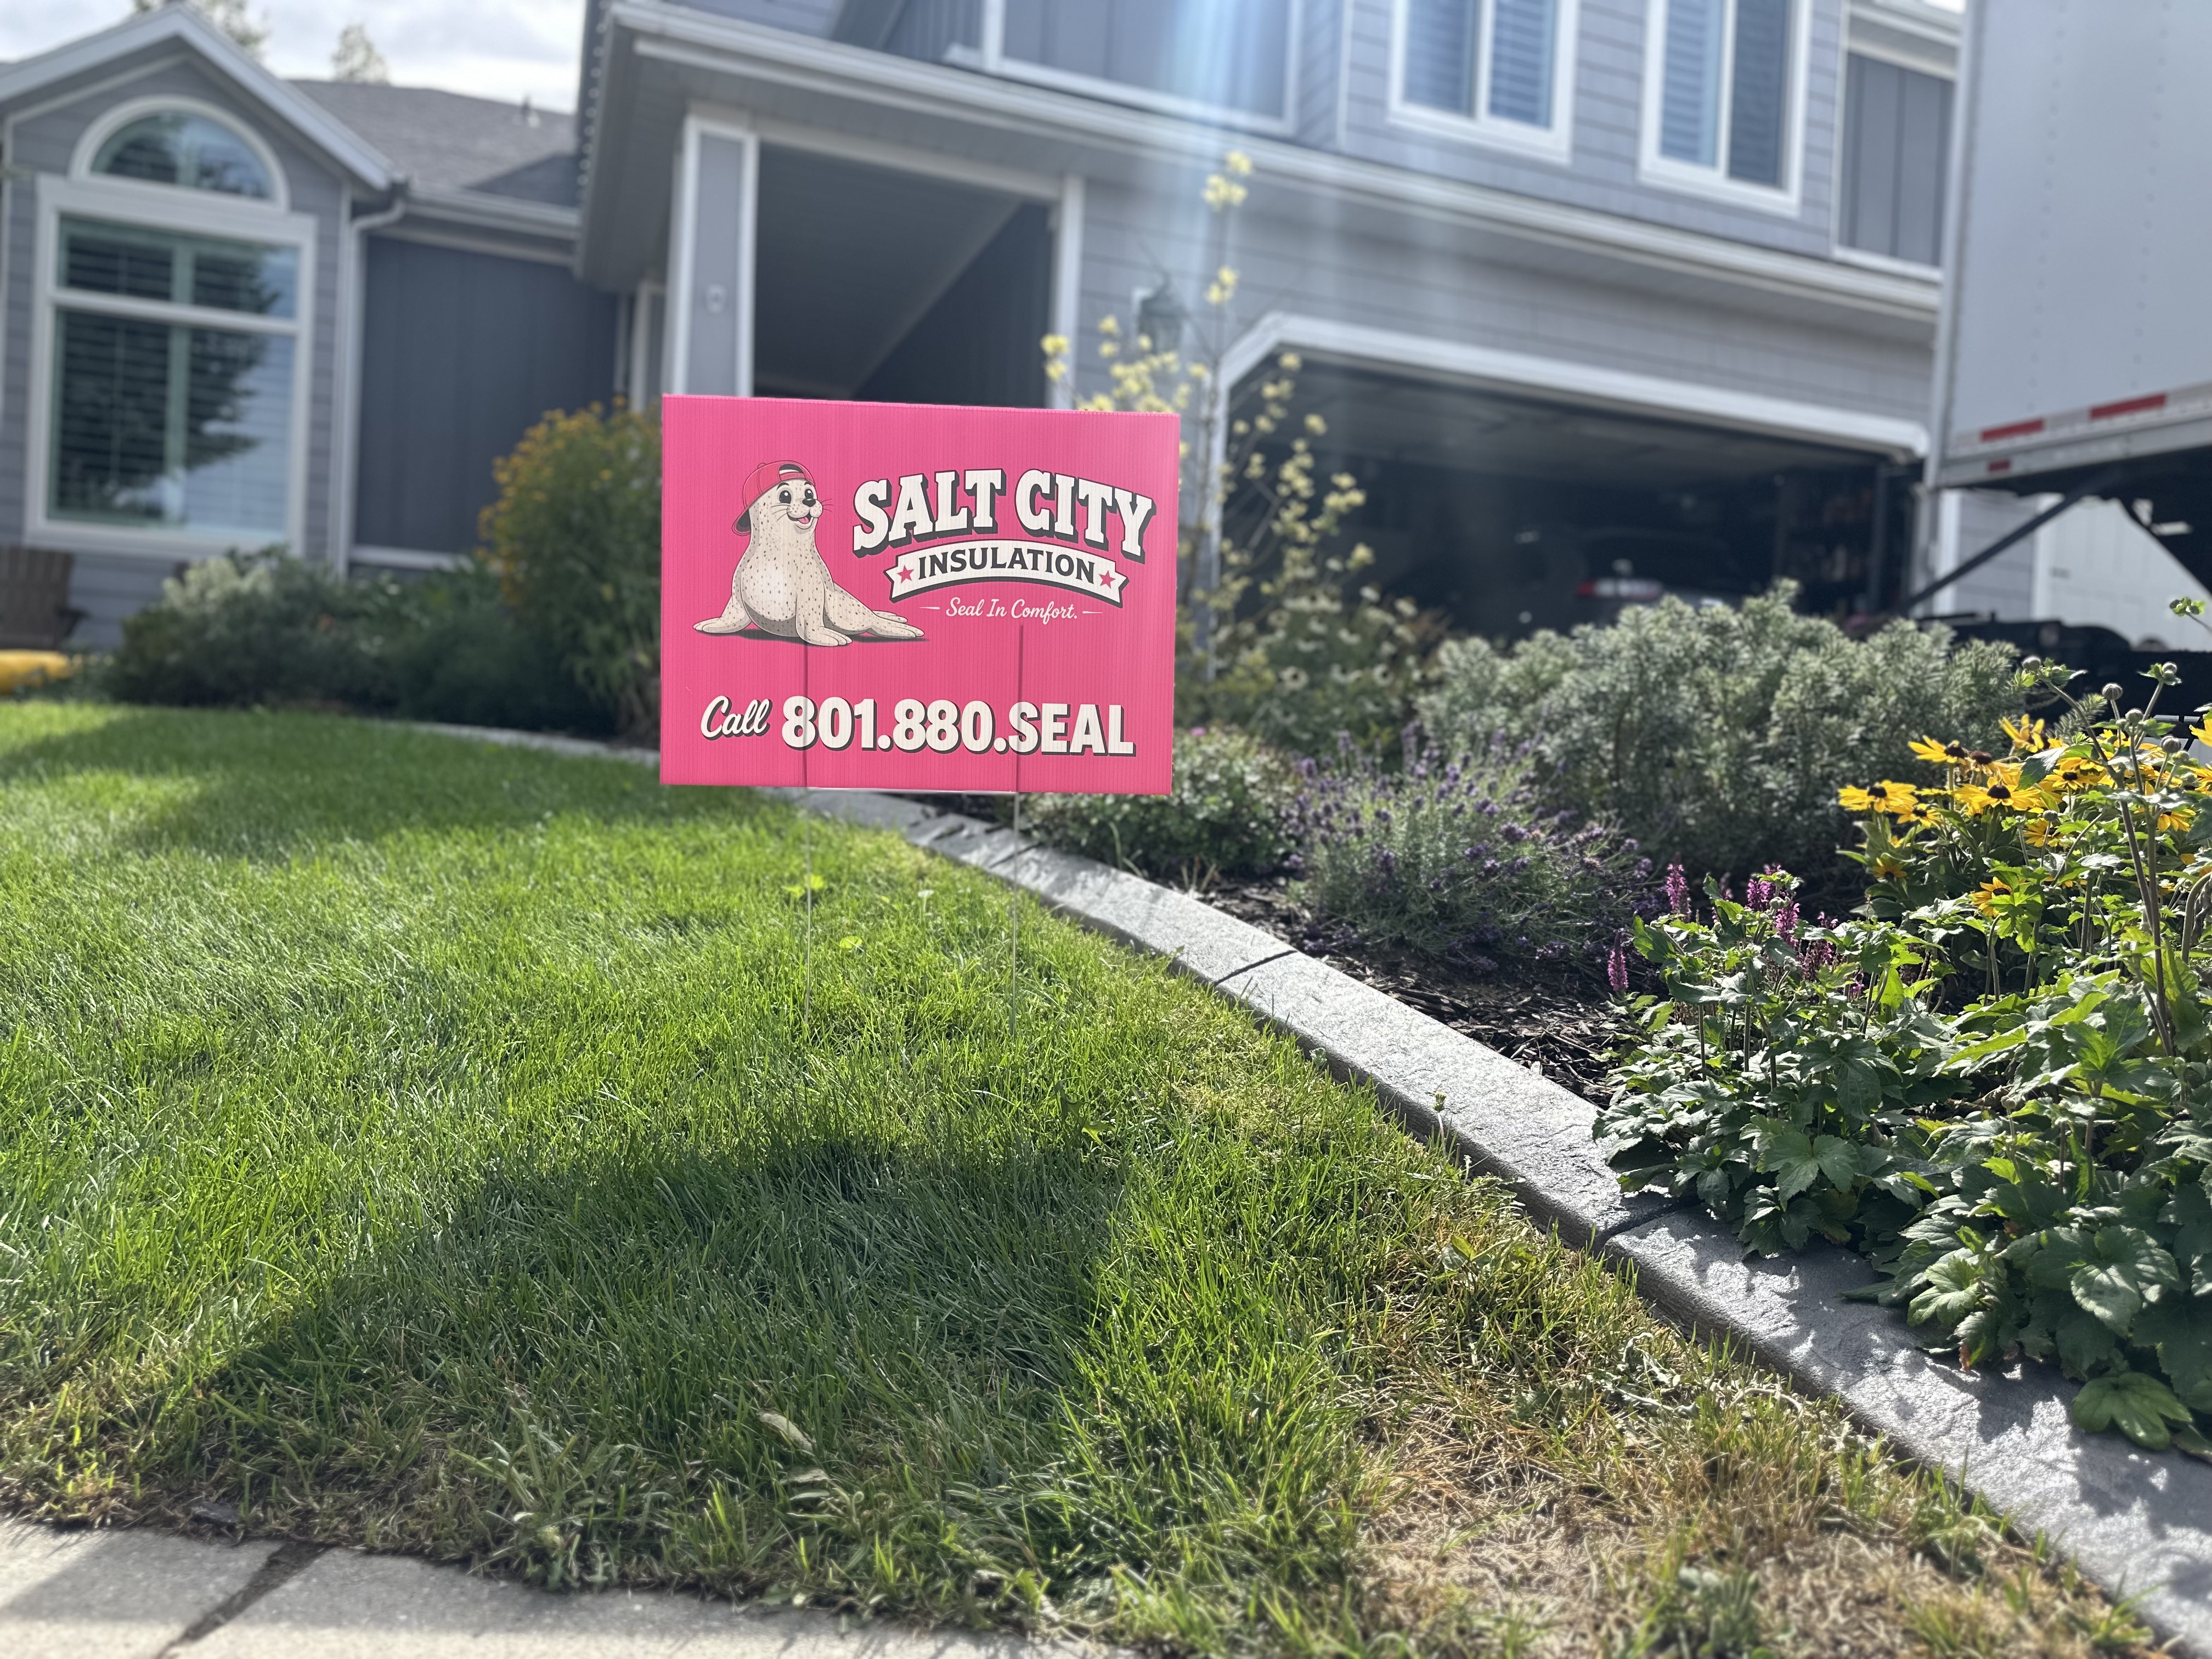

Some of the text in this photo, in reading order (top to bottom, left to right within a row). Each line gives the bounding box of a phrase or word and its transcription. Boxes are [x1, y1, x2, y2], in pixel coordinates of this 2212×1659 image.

[853, 468, 1157, 564] SALT CITY
[918, 546, 1095, 585] INSULATION
[945, 597, 1078, 625] Seal In Comfort.
[700, 695, 1137, 758] Call 801.880.SEAL
